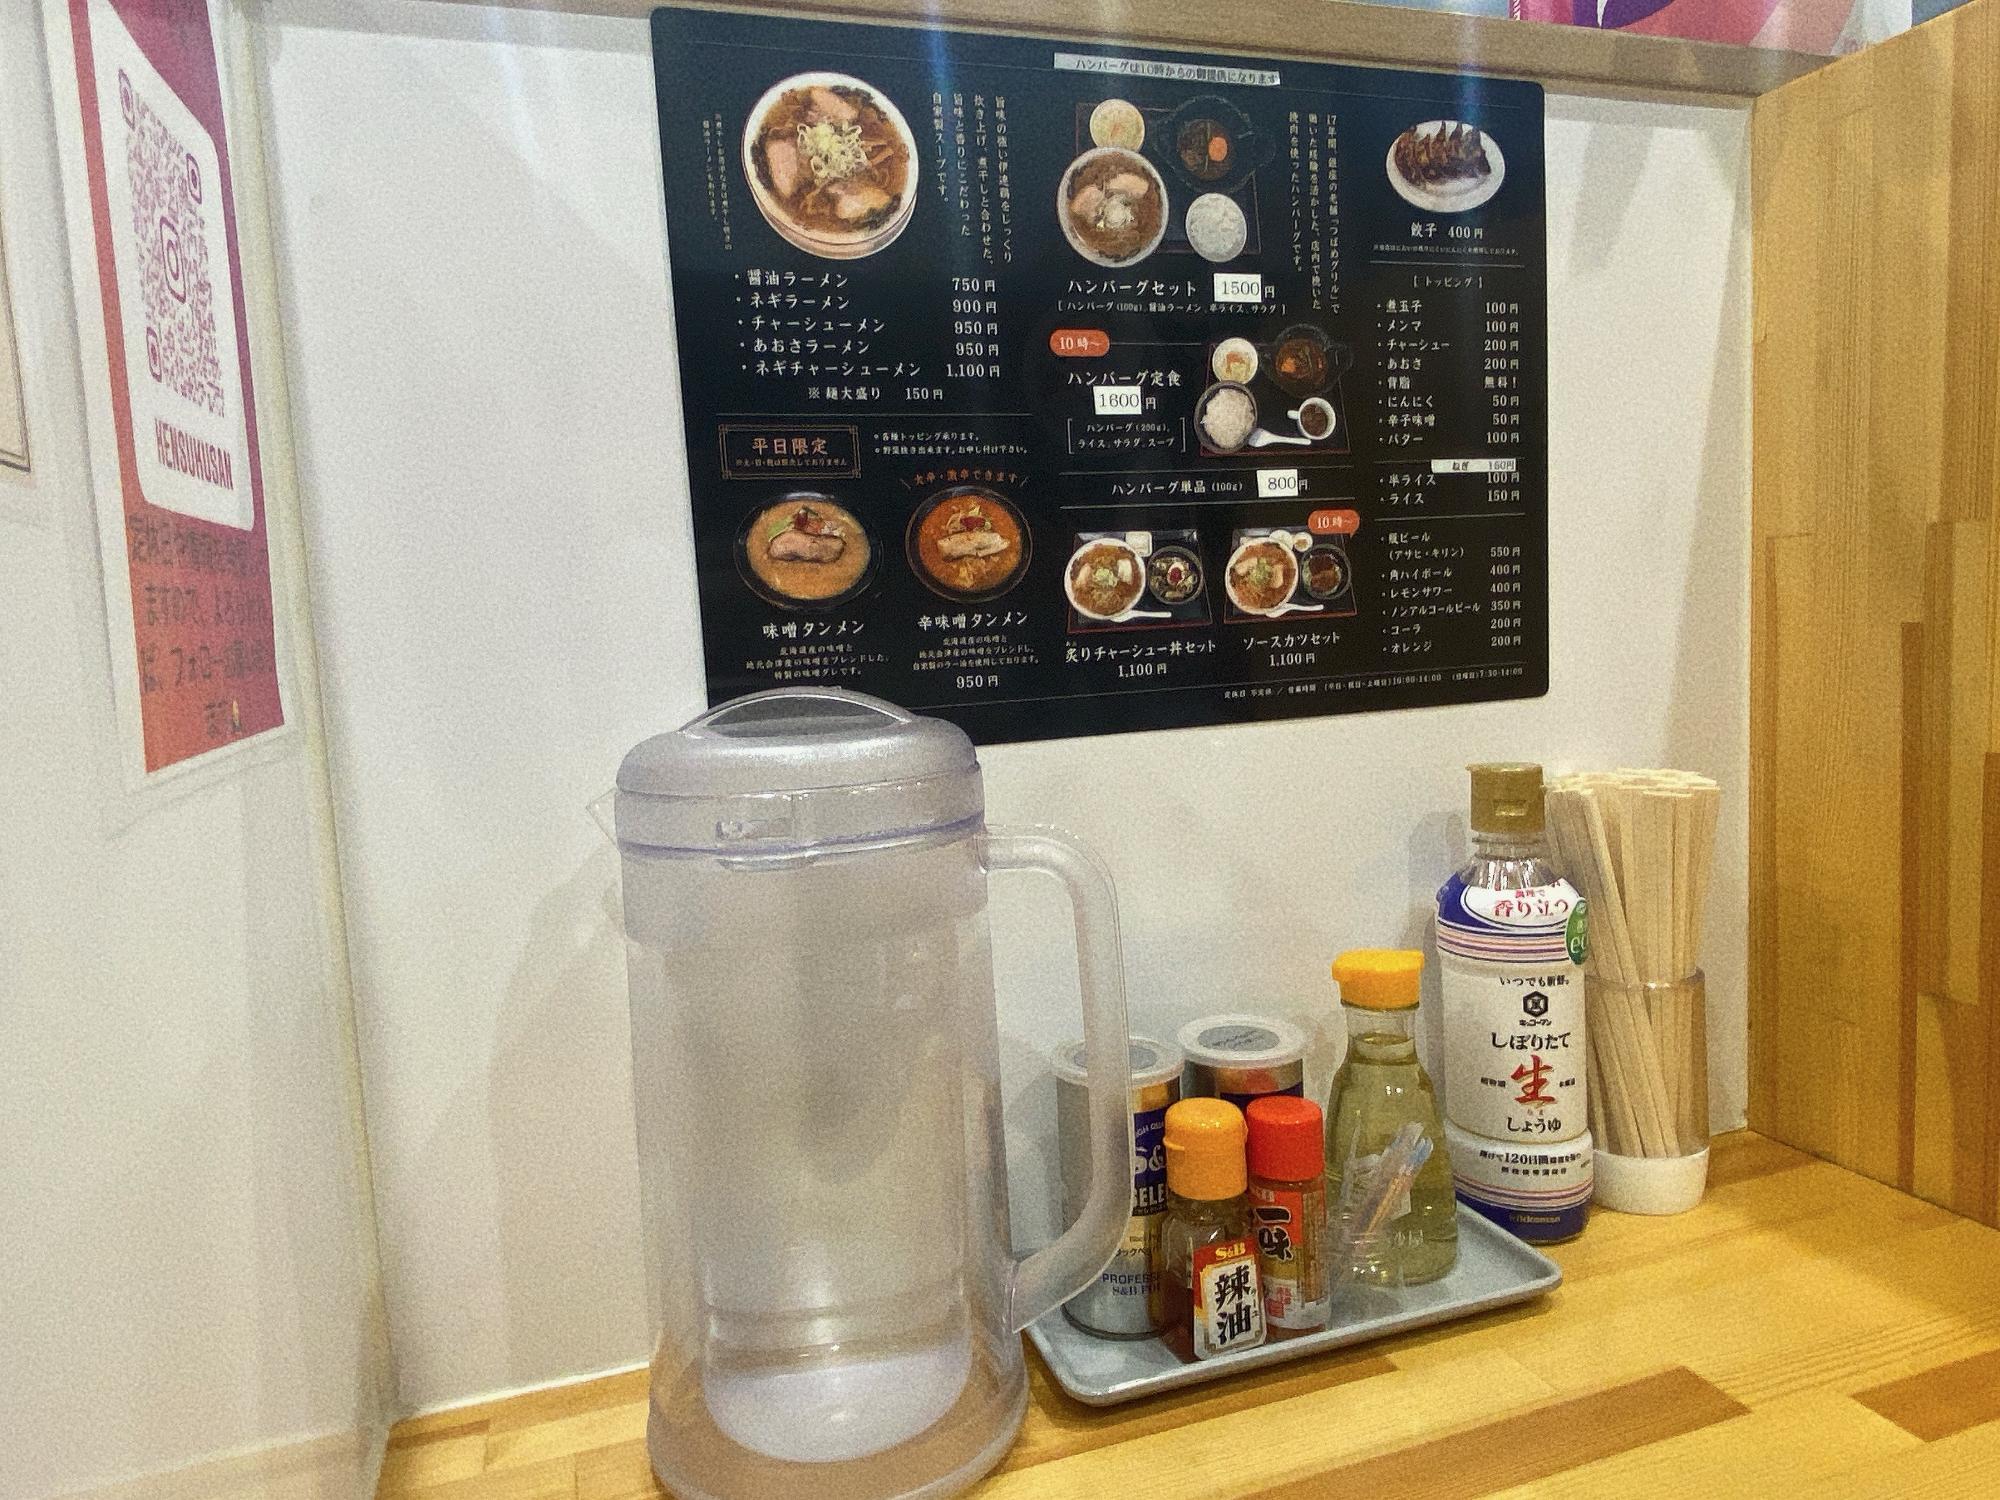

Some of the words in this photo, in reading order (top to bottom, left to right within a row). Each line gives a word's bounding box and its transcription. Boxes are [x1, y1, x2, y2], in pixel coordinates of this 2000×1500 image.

[1411, 222, 1438, 239] 餃子
[1448, 226, 1483, 240] 400円
[747, 269, 848, 287] 醤油ラーメン
[952, 277, 996, 293] 750円
[1067, 280, 1197, 297] ハンバーグセット
[1221, 281, 1260, 296] 1500
[1264, 284, 1275, 299] 円
[750, 292, 850, 310] ネギラーメン
[952, 300, 997, 315] 900円
[1386, 300, 1422, 313] 煮玉子
[1484, 302, 1519, 315] 100円
[751, 316, 885, 333] チャーシューメン
[954, 321, 998, 337] 950円
[1387, 320, 1422, 332] メンマ
[1485, 320, 1519, 333] 100円
[753, 339, 870, 355] あおさラーメン
[955, 342, 999, 358] 950円
[1387, 339, 1450, 351] チャーシュー
[1484, 340, 1519, 352] 200円
[756, 361, 921, 378] ネギチャーシューメン
[946, 364, 1000, 379] 1,100円
[1387, 357, 1422, 371] あおさ
[1484, 358, 1519, 370] 200円
[1067, 369, 1182, 387] ハンバーグ定食
[905, 387, 943, 401] 150円
[1100, 393, 1139, 408] 1600
[1145, 397, 1156, 410] 円
[1387, 395, 1434, 408] にんにく
[1492, 395, 1520, 408] 50円
[1387, 413, 1436, 427] 辛子味噌
[1492, 413, 1520, 426] 50円
[752, 437, 828, 455] 平日限定
[1388, 432, 1424, 446] バター
[1486, 432, 1520, 444] 100円
[1111, 479, 1207, 496] ハンバーグ単品
[1267, 475, 1297, 490] 800
[1299, 478, 1309, 491] 円
[1389, 493, 1425, 505] ライス
[1487, 490, 1520, 502] 150円
[1490, 546, 1521, 558] 550円
[1389, 567, 1453, 582] 角ハイボール
[1490, 564, 1521, 576] 400円
[1390, 586, 1453, 598] レモンサワー
[1490, 582, 1521, 594] 400円
[1391, 603, 1481, 618] ノンアルコールビール
[1491, 600, 1521, 612] 350円
[762, 620, 865, 639] 味噌タンメン
[917, 611, 1028, 631] 辛味噌タンメン
[1391, 623, 1421, 636] コーラ
[1491, 617, 1521, 630] 200円
[1244, 632, 1341, 650] ソースカツセット
[1391, 641, 1432, 654] オレンジ
[1491, 635, 1522, 648] 200円
[1065, 640, 1216, 663] 炙りチャーシュー丼セット
[1268, 653, 1316, 667] 1,100円
[1118, 663, 1167, 678] 1,100円
[956, 674, 999, 689] 950円
[1491, 1032, 1571, 1051] しぼりたて
[1511, 1054, 1557, 1105] 生
[1507, 1117, 1561, 1133] しょうゆ
[1254, 1206, 1293, 1261] 一味
[1215, 1243, 1246, 1261] S&B
[1215, 1265, 1252, 1346] 辣油
